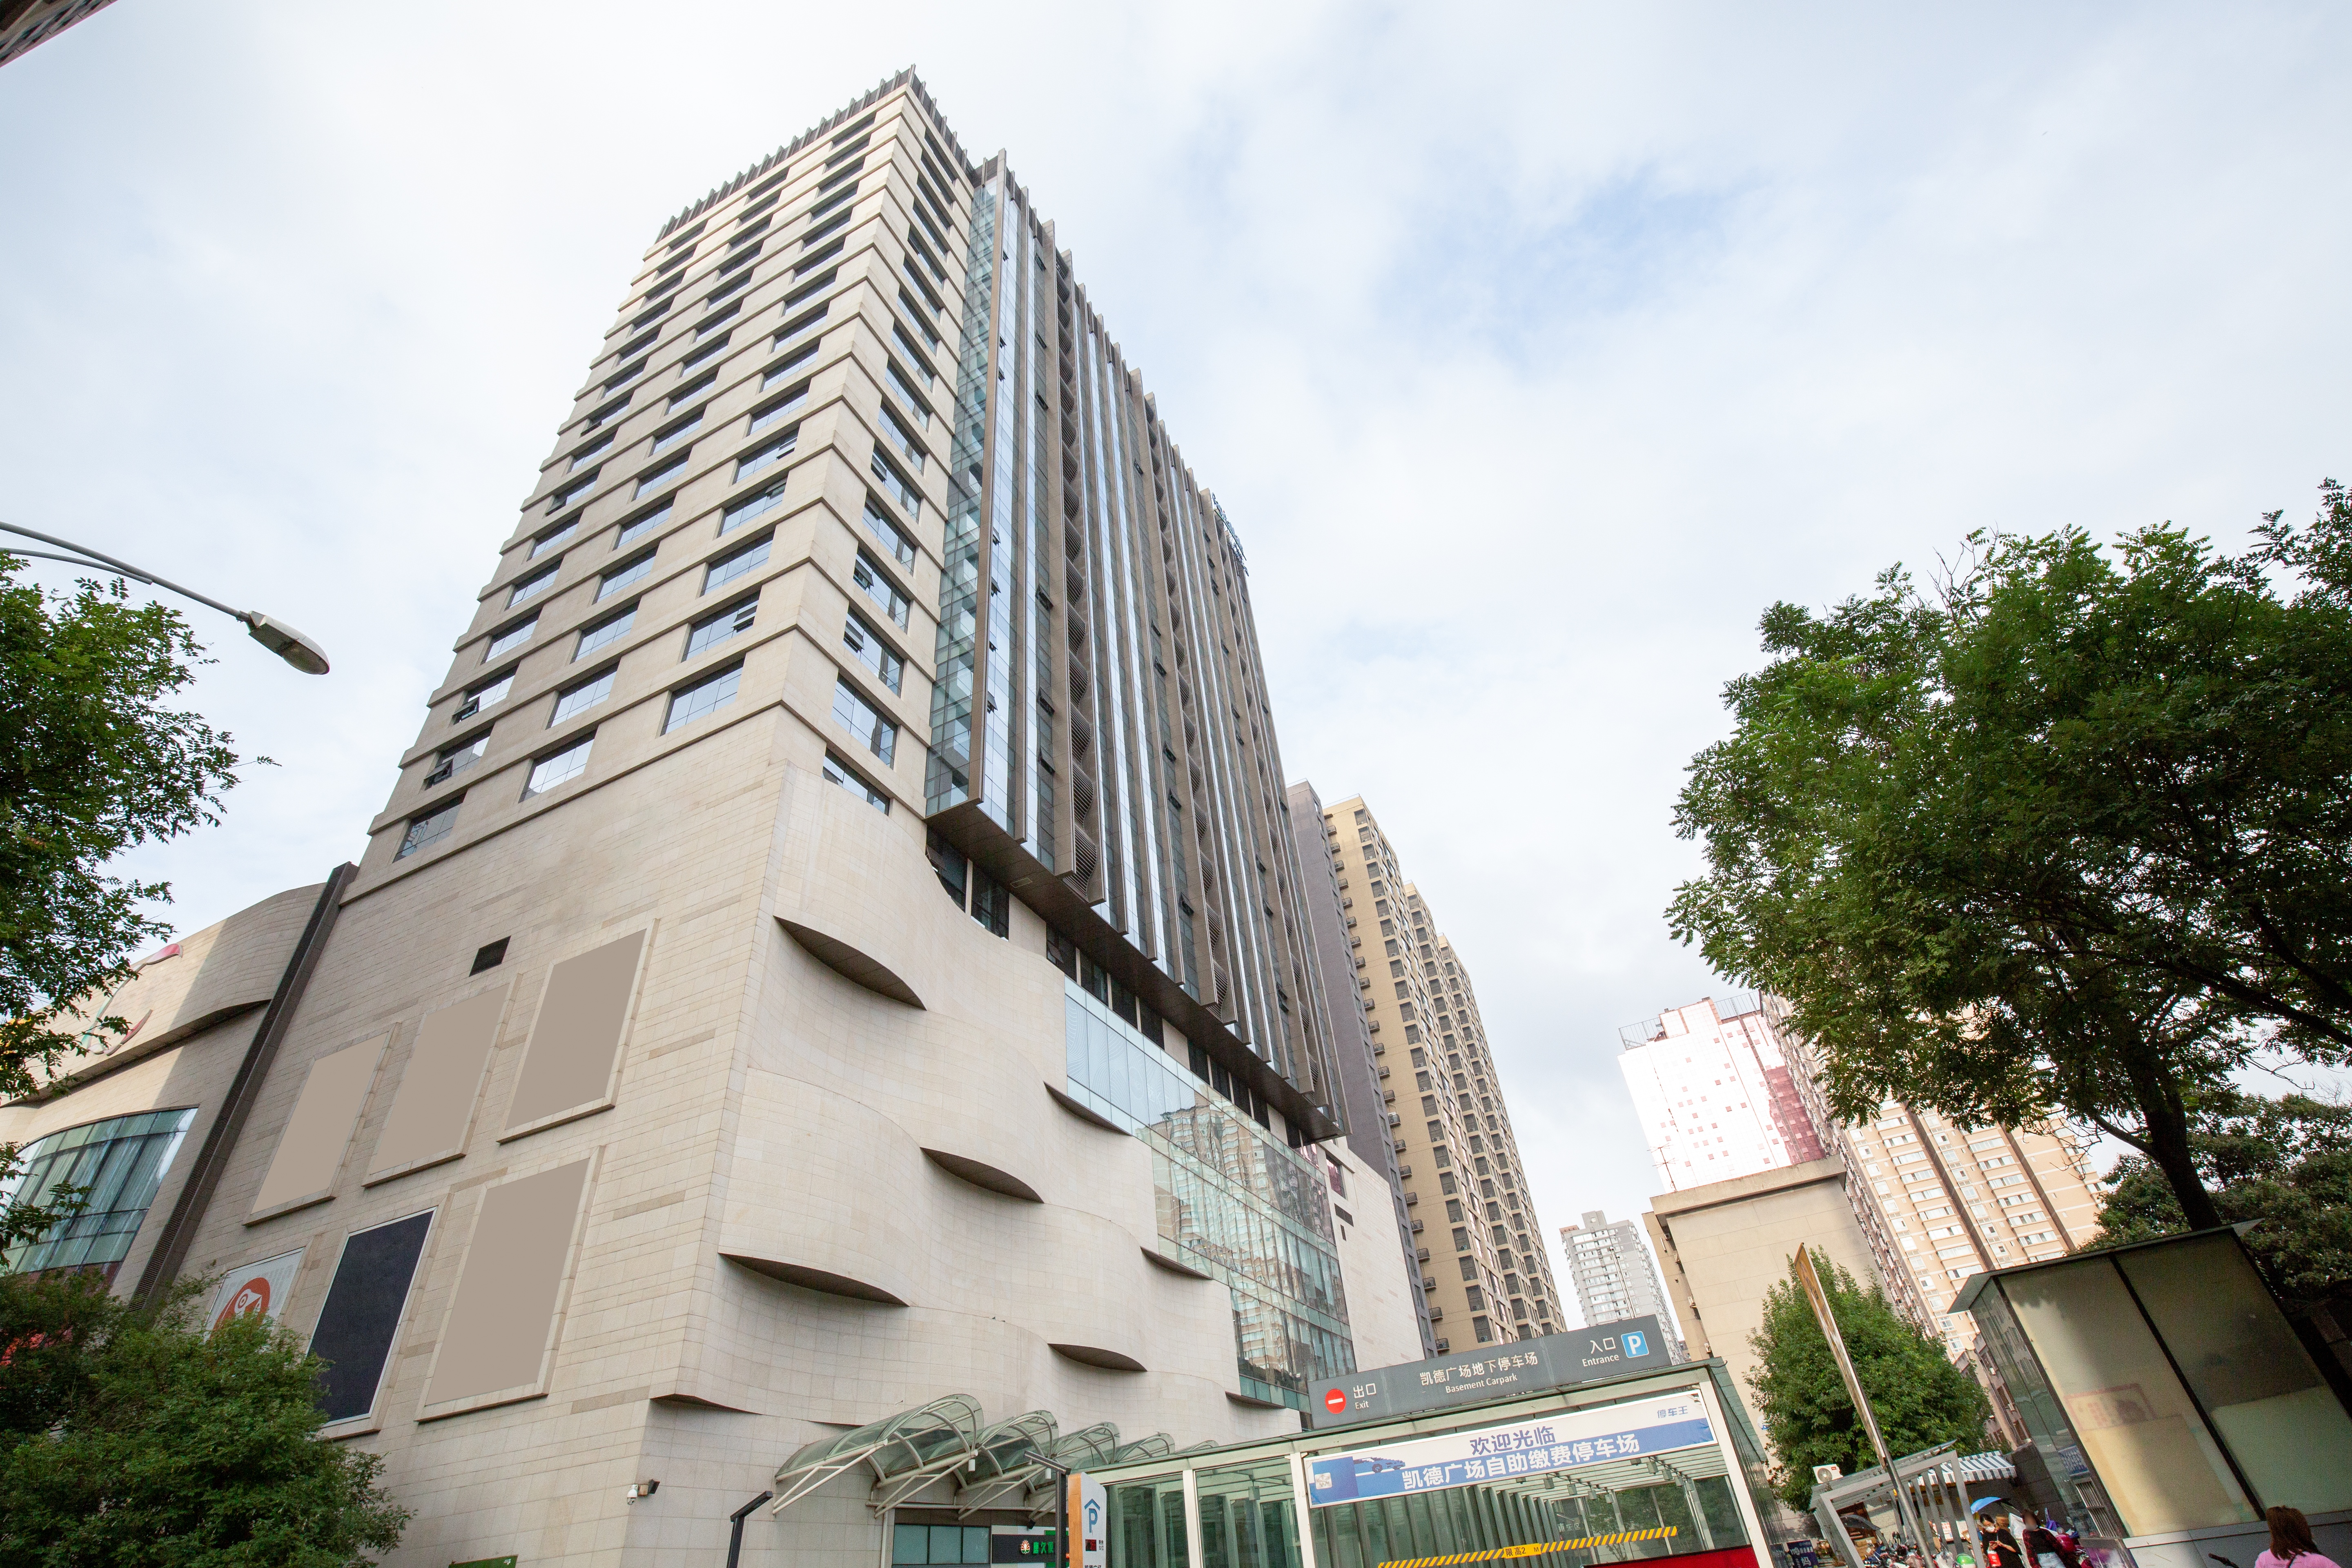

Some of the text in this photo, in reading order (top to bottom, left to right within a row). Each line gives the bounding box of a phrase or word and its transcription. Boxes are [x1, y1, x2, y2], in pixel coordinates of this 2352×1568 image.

[1590, 1337, 1616, 1354] 入口
[1627, 1335, 1641, 1354] P
[1419, 1351, 1538, 1386] 凯德广场地下停车场
[1582, 1354, 1619, 1367] Entrance
[1353, 1383, 1376, 1399] 出口
[1445, 1373, 1518, 1394] Basement Carpark
[1355, 1400, 1369, 1410] Exit
[1657, 1405, 1688, 1419] 停车王
[1470, 1426, 1556, 1456] 欢迎光临
[1401, 1433, 1640, 1490] 凯德广场自助缴费停车场
[1089, 1508, 1098, 1533] P
